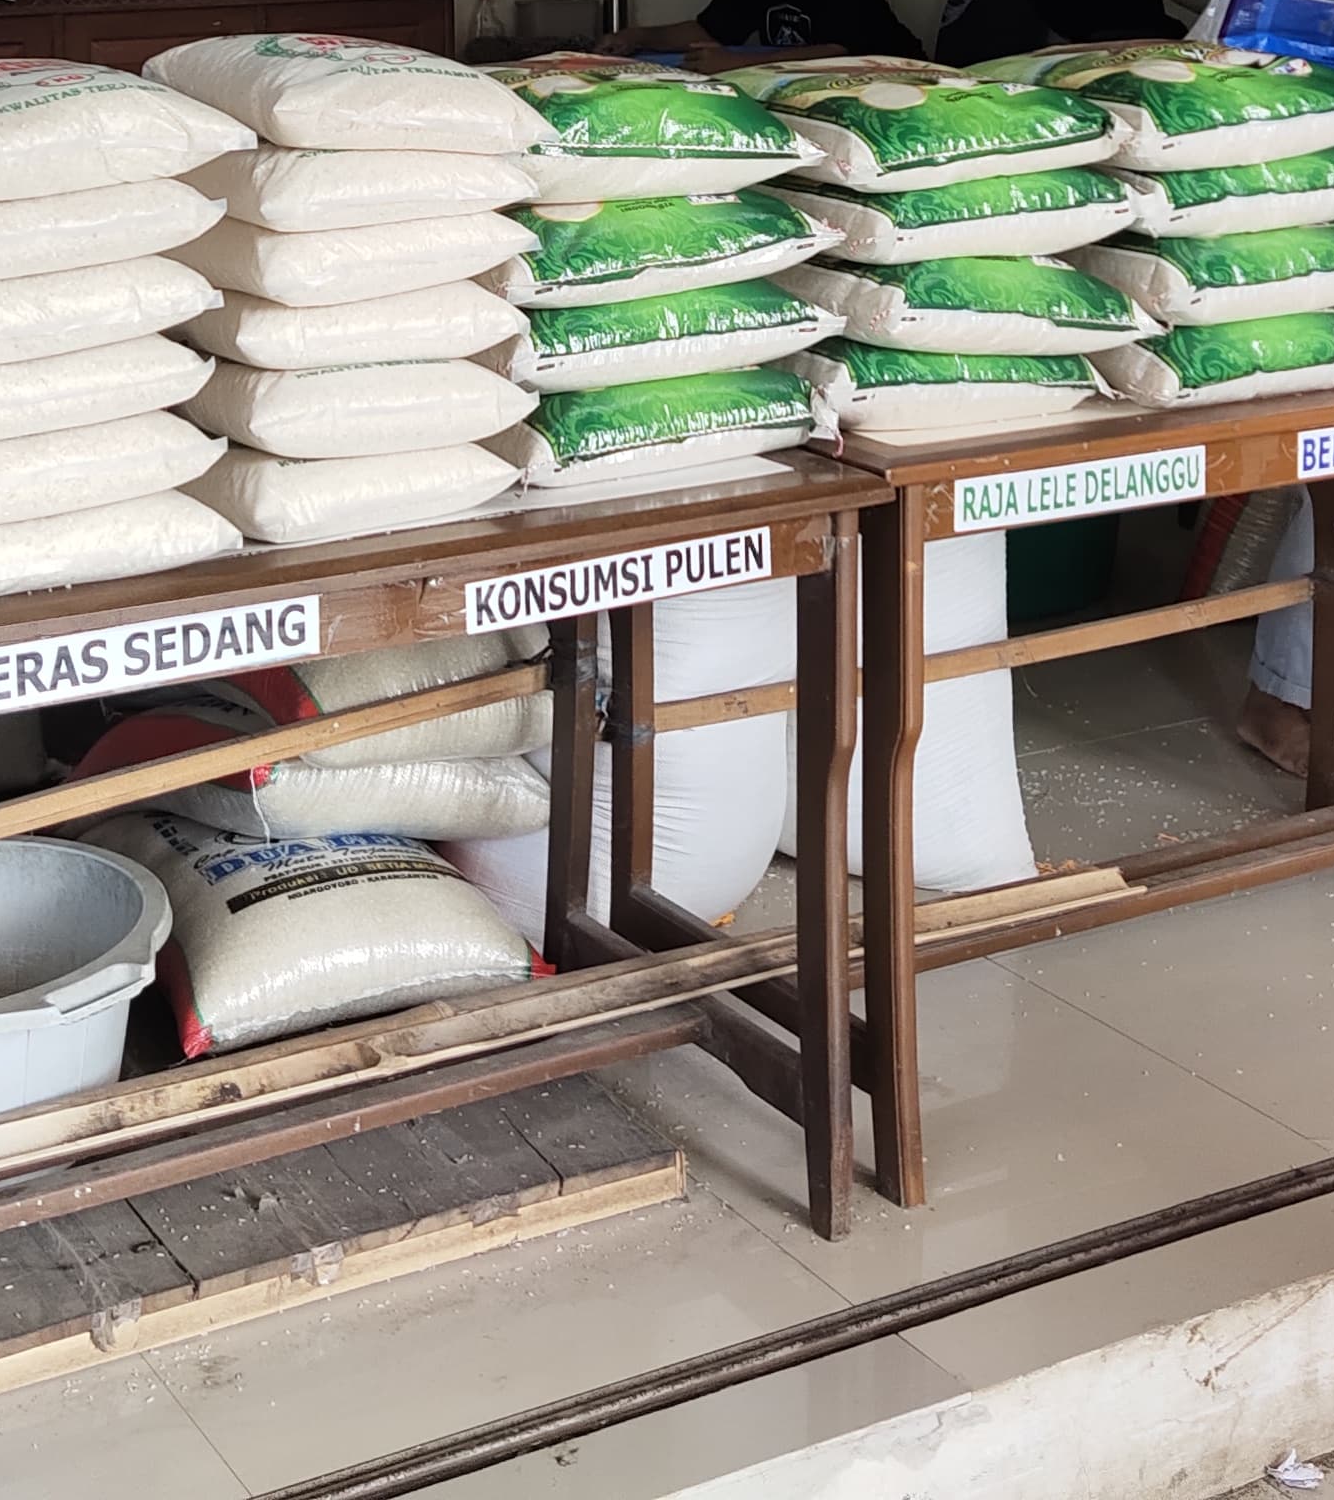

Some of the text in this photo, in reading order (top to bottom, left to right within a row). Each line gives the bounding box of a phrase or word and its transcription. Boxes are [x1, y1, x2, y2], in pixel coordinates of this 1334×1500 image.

[963, 452, 1202, 521] RAJA LELE DELANGGU
[473, 531, 766, 626] KONSUMSI PULEN
[123, 603, 308, 677] SEDANG
